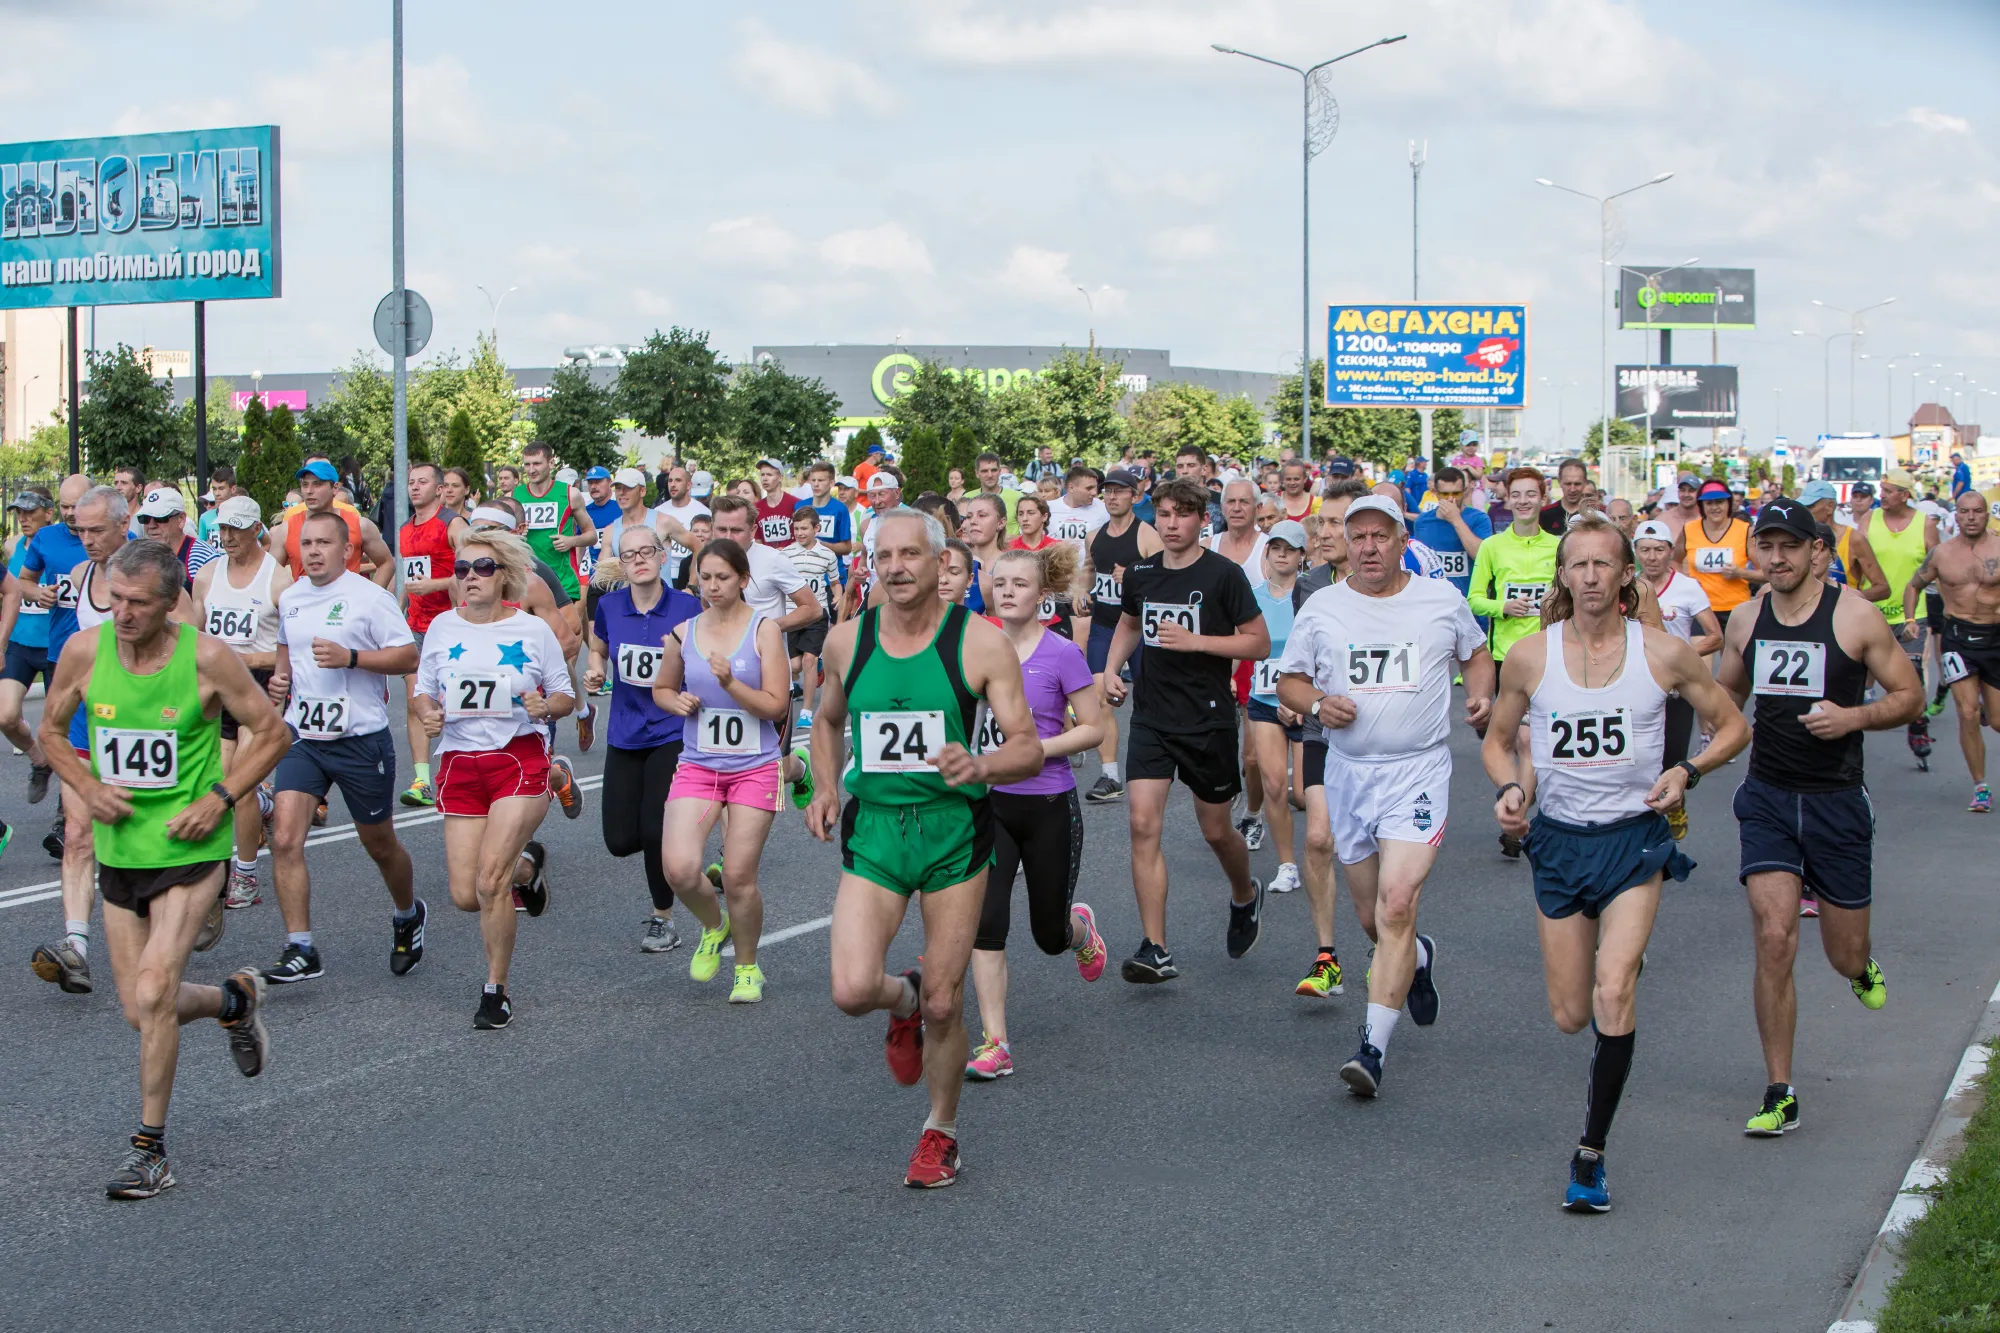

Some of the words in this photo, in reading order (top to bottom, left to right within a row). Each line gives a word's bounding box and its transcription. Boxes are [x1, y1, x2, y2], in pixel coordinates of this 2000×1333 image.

[1, 147, 259, 238] ЖЛОБИН
[2, 259, 52, 285] наш
[57, 246, 181, 282] любимый
[187, 248, 261, 278] город
[1335, 367, 1518, 386] www.mega-hand.by
[1336, 355, 1427, 367] СЕКОНД-ХЕНД
[526, 506, 556, 524] 122
[764, 523, 787, 538] 545
[1059, 524, 1086, 540] 103
[1704, 552, 1723, 568] 44
[209, 611, 252, 638] 564
[1348, 648, 1410, 685] 571
[1768, 649, 1809, 687] 22
[459, 680, 496, 709] 27
[299, 701, 343, 732] 242
[708, 715, 743, 746] 10
[879, 721, 928, 762] 24
[1551, 715, 1625, 759] 255
[104, 737, 173, 778] 149
